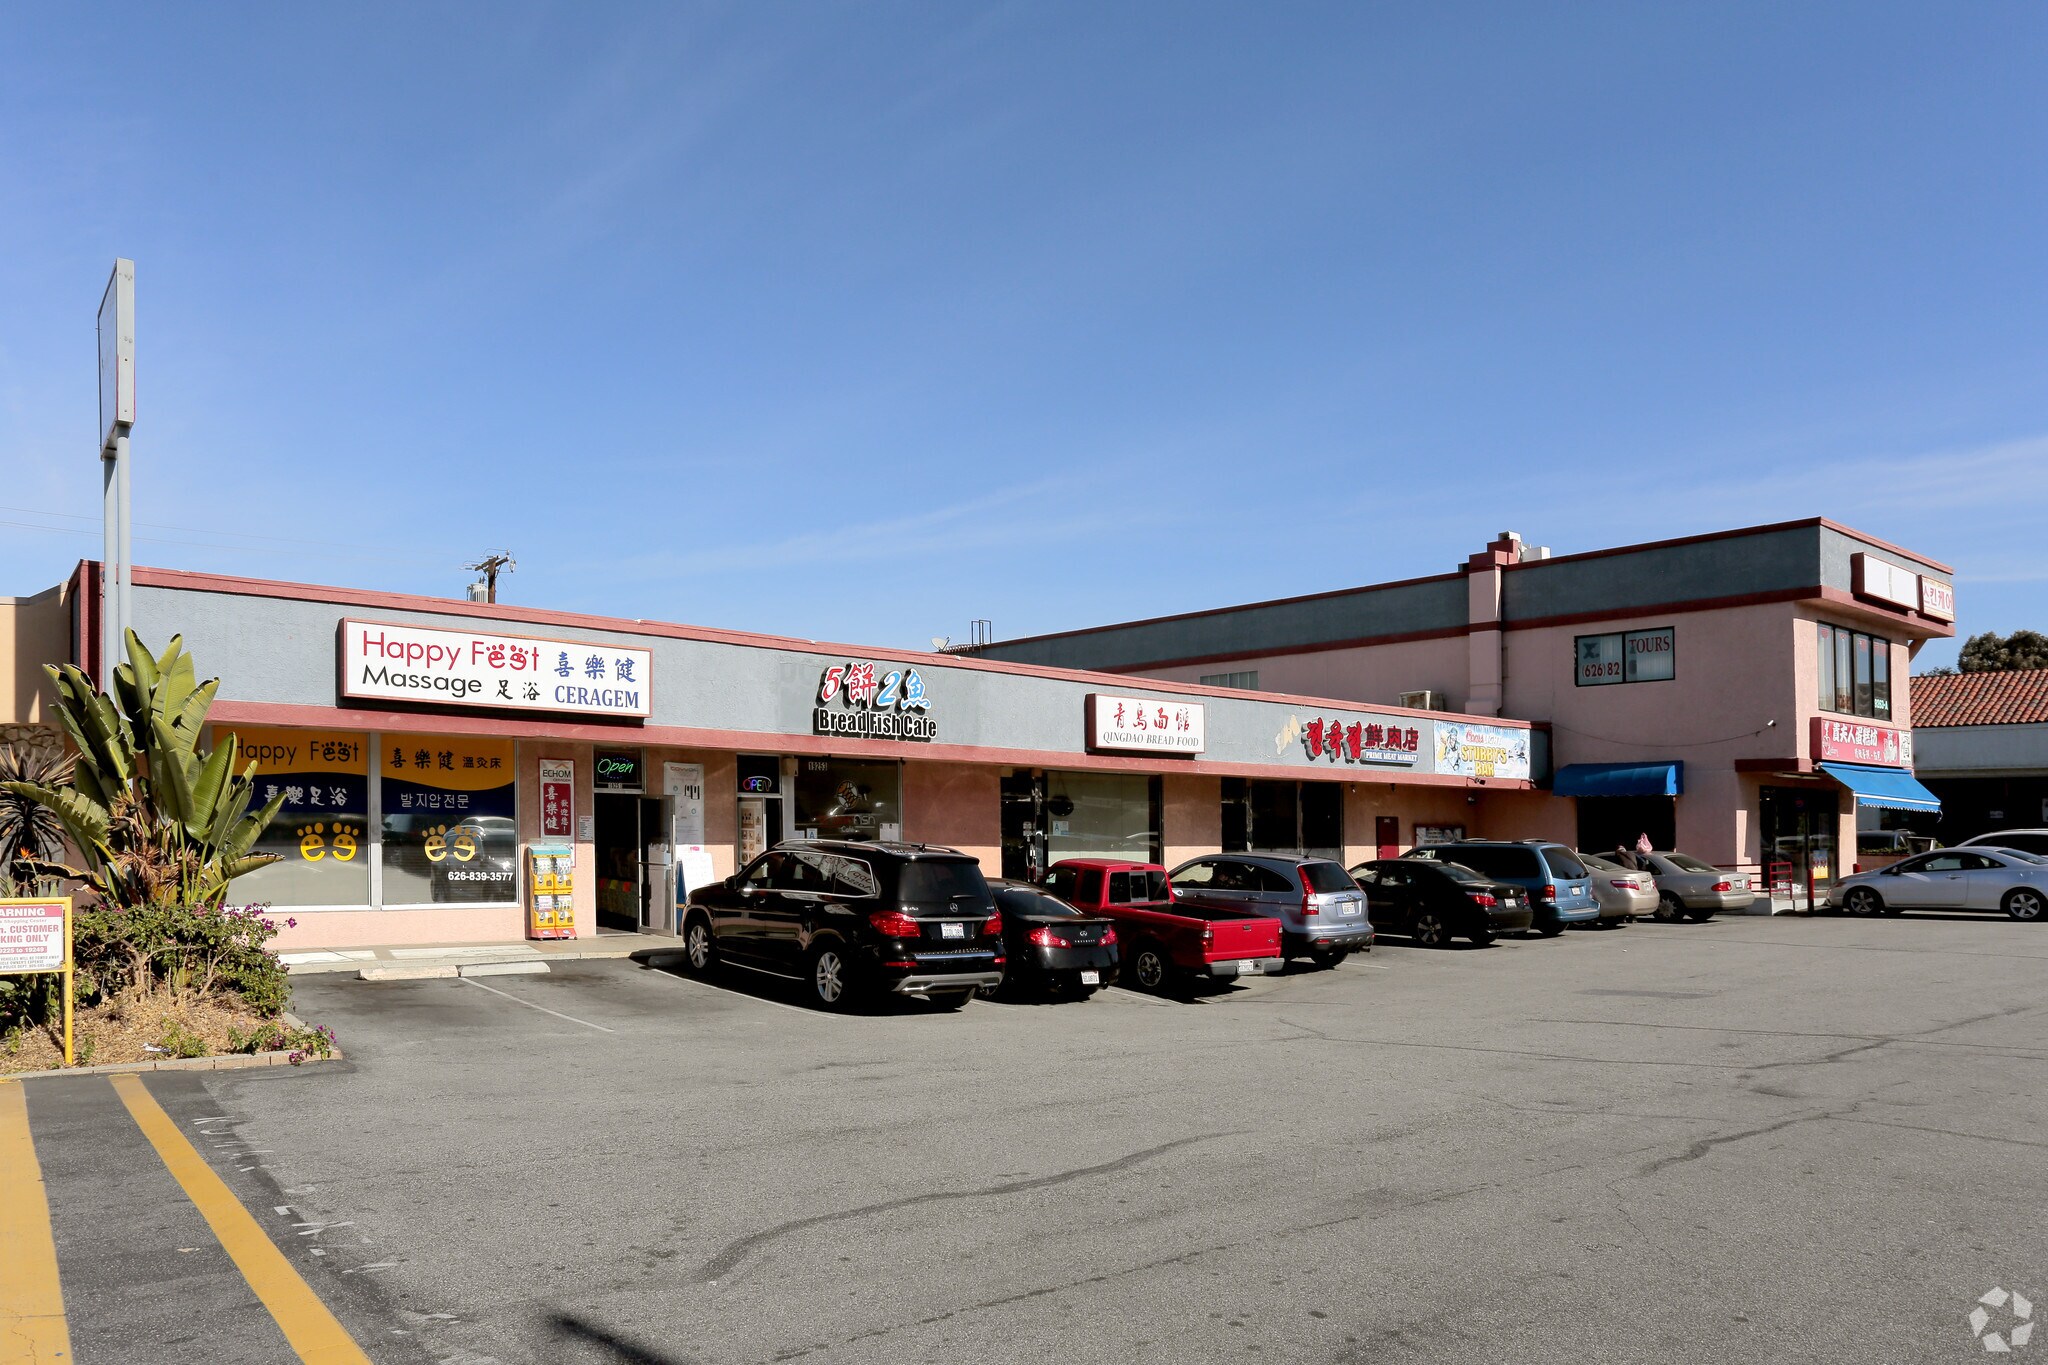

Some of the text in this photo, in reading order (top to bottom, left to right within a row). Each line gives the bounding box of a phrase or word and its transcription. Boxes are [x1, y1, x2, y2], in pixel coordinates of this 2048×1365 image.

[362, 630, 461, 670] Happy
[1629, 636, 1670, 653] TOURS
[553, 651, 637, 683] 喜樂健
[362, 664, 541, 701] Massage 足浴
[554, 685, 640, 709] CERAGEM
[818, 709, 938, 738] Bread Fish Cafe
[1103, 732, 1199, 748] QINGDAO BREAD FOOD
[1364, 723, 1419, 751] 鮮肉店
[389, 747, 455, 771] 喜樂健
[1461, 745, 1507, 764] STUBBY'S
[542, 769, 572, 778] ECHOM
[597, 759, 634, 777] Open
[1475, 762, 1495, 777] BAR
[743, 778, 770, 792] OPEN
[448, 871, 514, 882] 626-839-3577
[10, 924, 59, 933] CUSTOMER
[26, 934, 49, 943] ONLY
